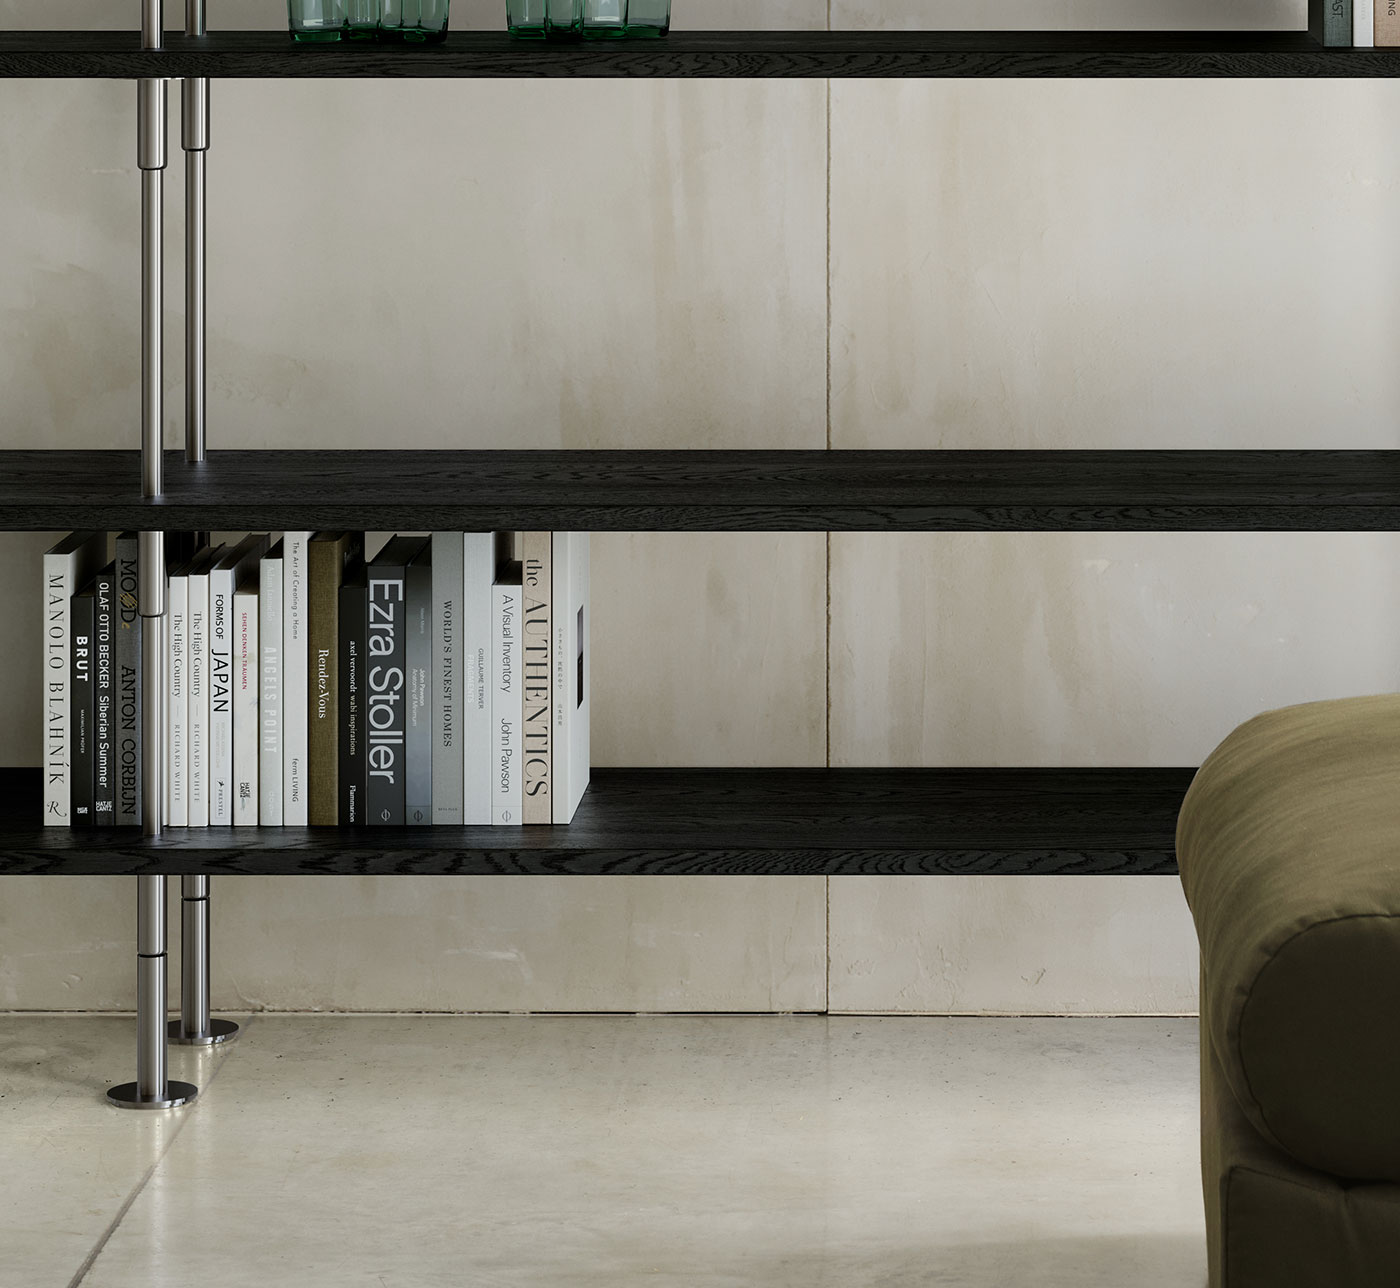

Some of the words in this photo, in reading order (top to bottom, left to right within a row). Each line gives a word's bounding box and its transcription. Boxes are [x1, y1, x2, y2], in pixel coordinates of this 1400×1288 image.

[292, 541, 300, 553] The
[292, 556, 300, 568] Art
[292, 570, 300, 578] of
[526, 559, 543, 587] the
[99, 582, 110, 611] OLAF
[215, 593, 224, 627] FORMS
[290, 579, 300, 610] Creating
[502, 594, 514, 605] A
[49, 574, 65, 670] MANOLO
[99, 613, 110, 641] OTTO
[174, 613, 182, 631] The
[193, 611, 202, 630] The
[215, 627, 224, 640] OF
[292, 619, 300, 640] Home
[368, 579, 404, 657] Ezra
[443, 600, 453, 654] WORLD'S
[502, 606, 514, 639] Visual
[76, 635, 88, 682] BRUT
[172, 633, 183, 657] High
[191, 632, 202, 656] High
[99, 644, 110, 689] BECKER
[172, 658, 182, 698] Country
[192, 657, 202, 697] Country
[211, 648, 229, 712] JAPAN
[263, 646, 277, 701] ANGELS
[318, 648, 330, 719] Rendez-Vous
[443, 657, 453, 701] FINEST
[501, 641, 514, 693] Inventory
[121, 664, 137, 731] ANTON
[524, 596, 549, 797] AUTHENTICS
[49, 682, 70, 785] BLAHNÍK
[99, 695, 110, 739] Siberian
[263, 708, 277, 754] POINT
[348, 714, 357, 756] inspirations
[368, 665, 404, 784] Stoller
[443, 705, 453, 748] HOMES
[501, 718, 512, 747] John
[99, 742, 110, 788] Summer
[121, 738, 137, 815] CORBIJN
[291, 758, 300, 776] ferm
[501, 749, 512, 793] Pawson
[291, 777, 300, 803] LIVING
[349, 784, 357, 823] Flammarion
